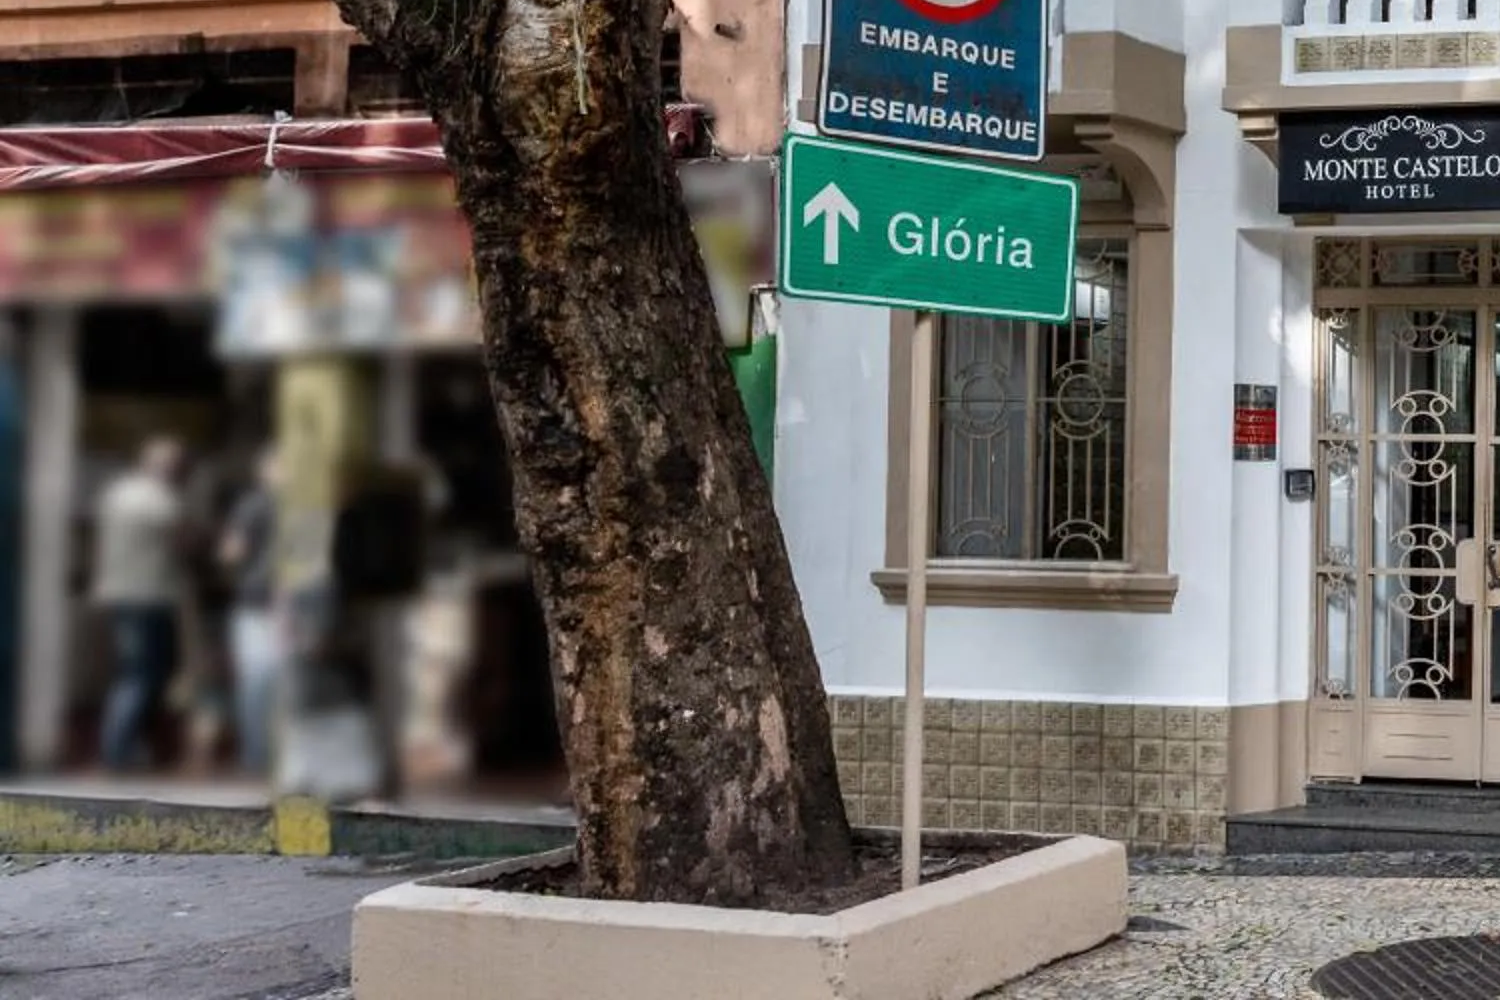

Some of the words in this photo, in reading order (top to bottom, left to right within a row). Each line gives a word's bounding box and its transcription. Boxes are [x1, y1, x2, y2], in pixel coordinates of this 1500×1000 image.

[859, 21, 1017, 70] EMBARQUE
[932, 71, 949, 94] E
[827, 90, 1038, 143] DESEMBARQUE
[1303, 157, 1388, 181] MONTE
[1365, 184, 1435, 199] HOTEL
[886, 211, 1035, 270] Glória
